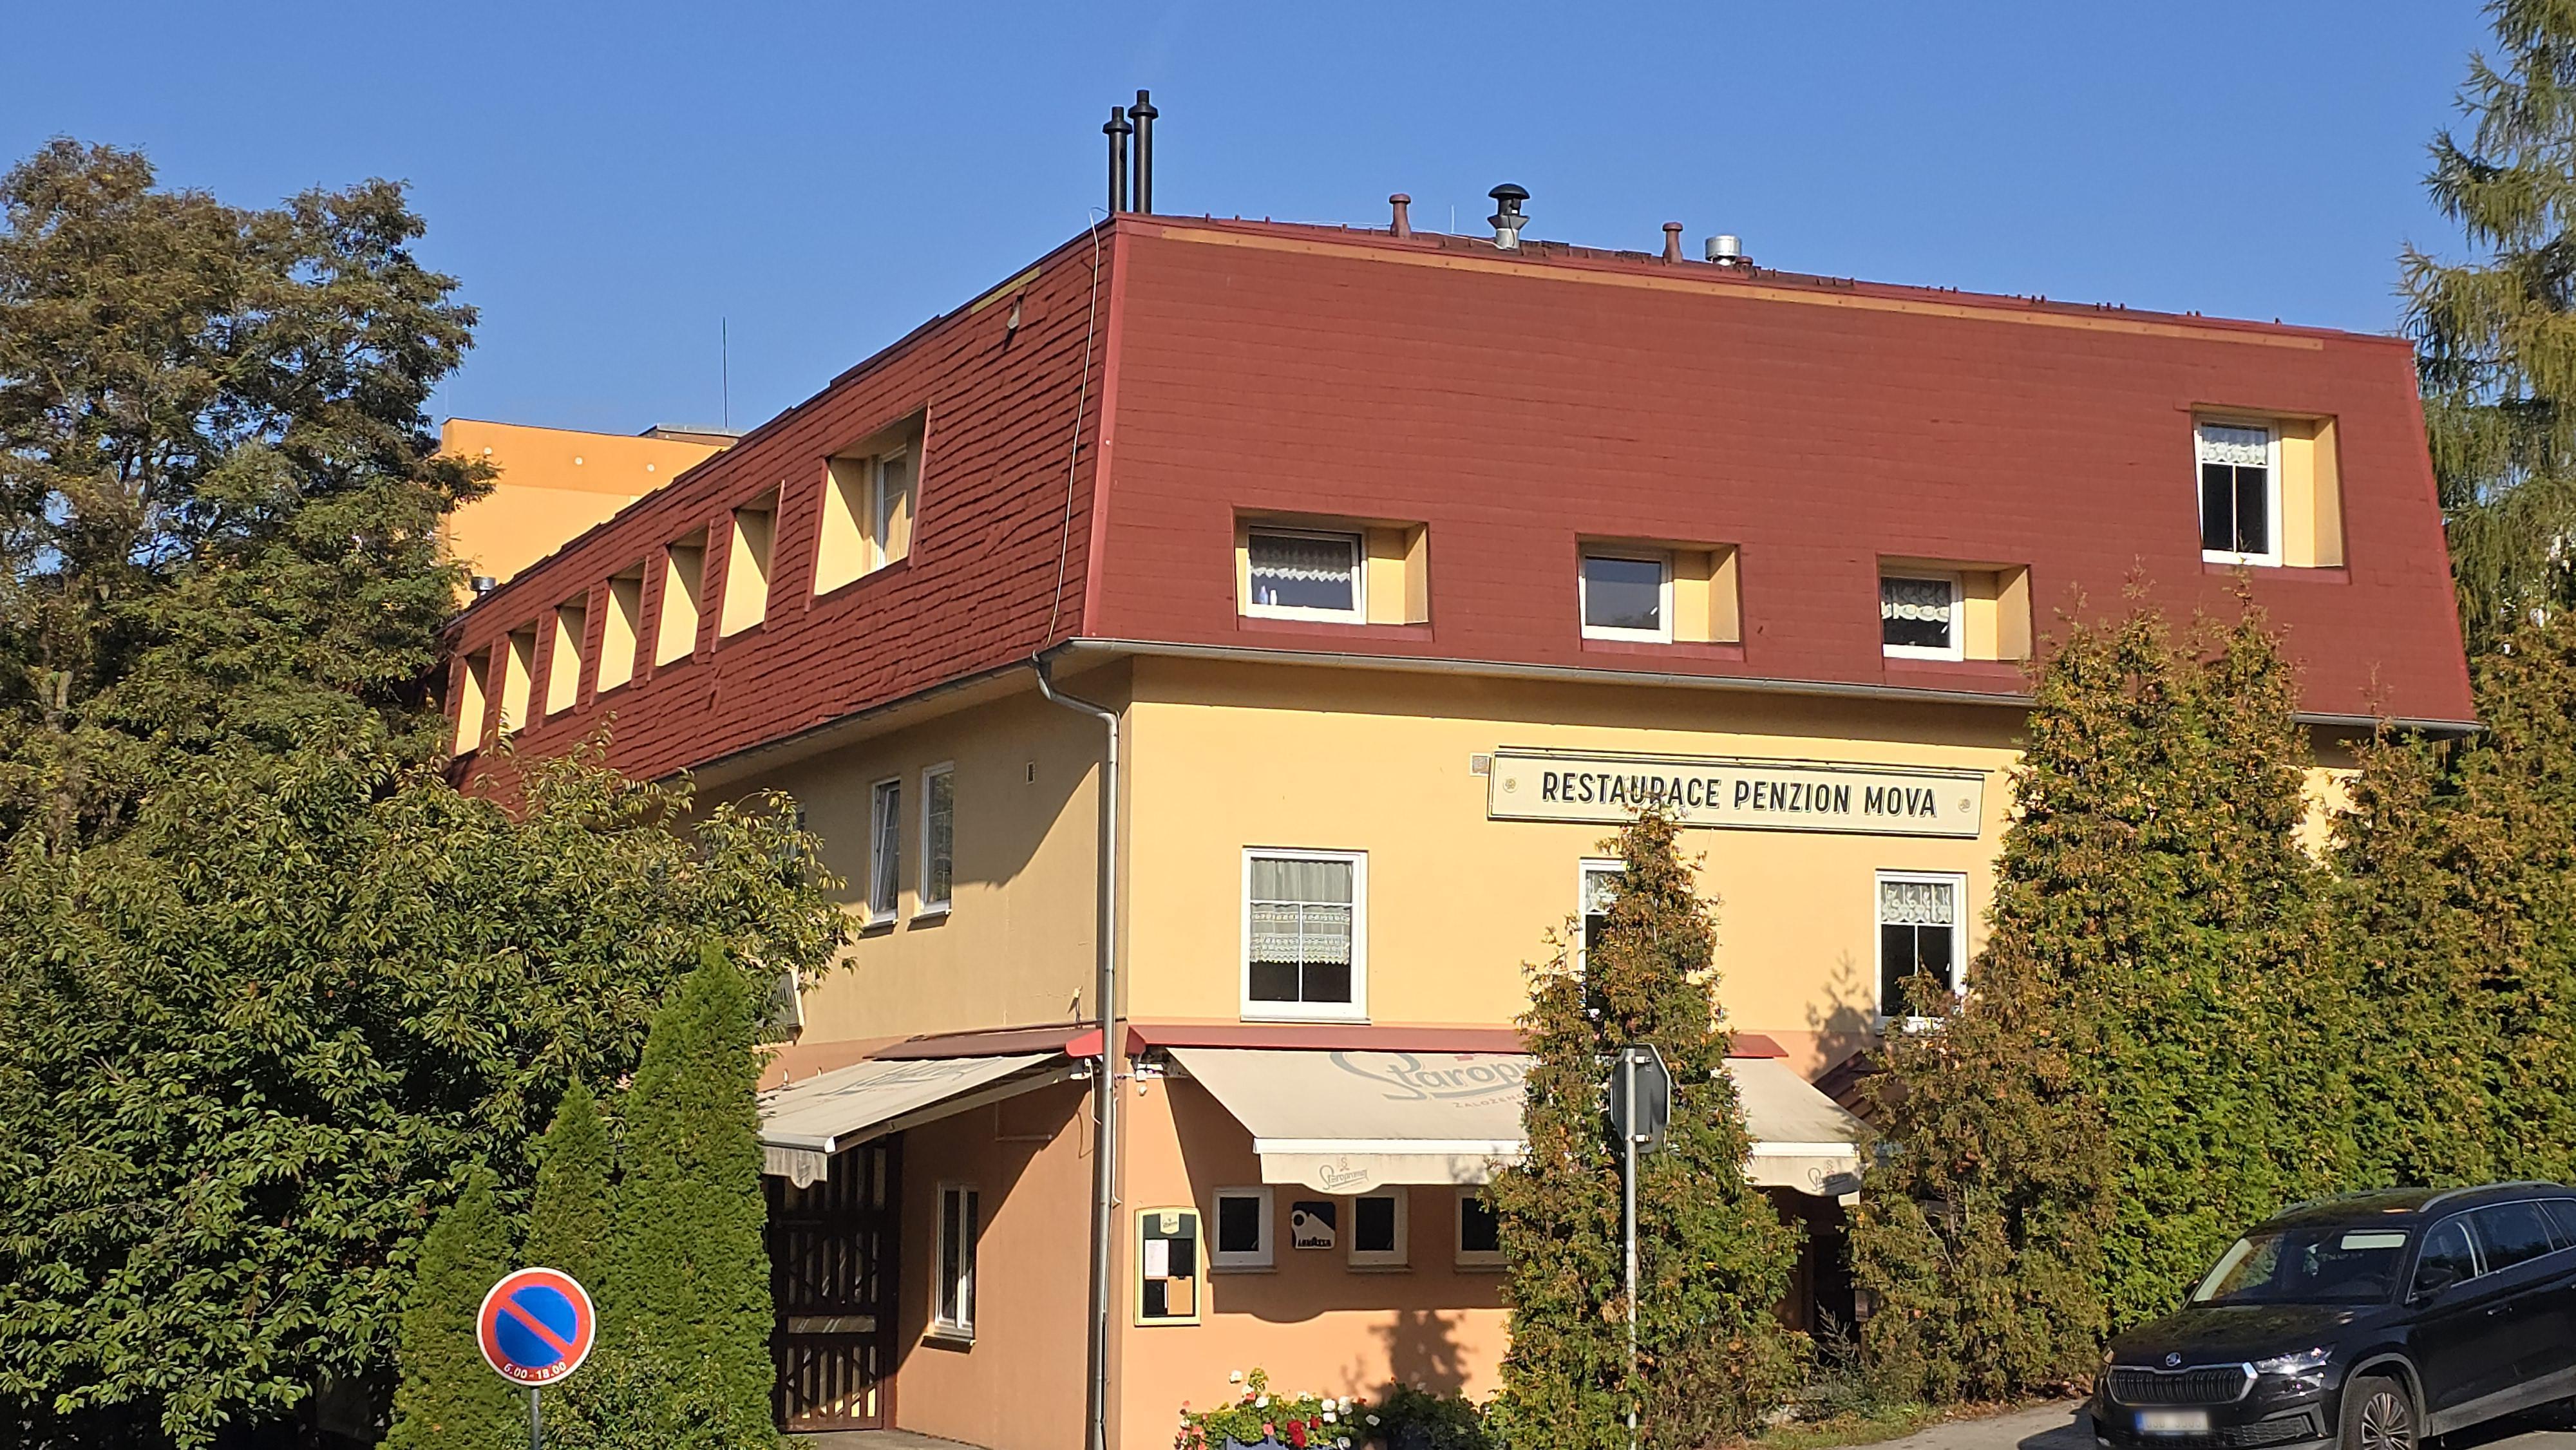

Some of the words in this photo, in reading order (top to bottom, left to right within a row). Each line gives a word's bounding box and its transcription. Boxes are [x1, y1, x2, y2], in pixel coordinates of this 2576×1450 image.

[1542, 771, 1721, 809] RESTAURACE
[1734, 780, 1851, 814] PENZION
[1864, 786, 1937, 817] MOVA
